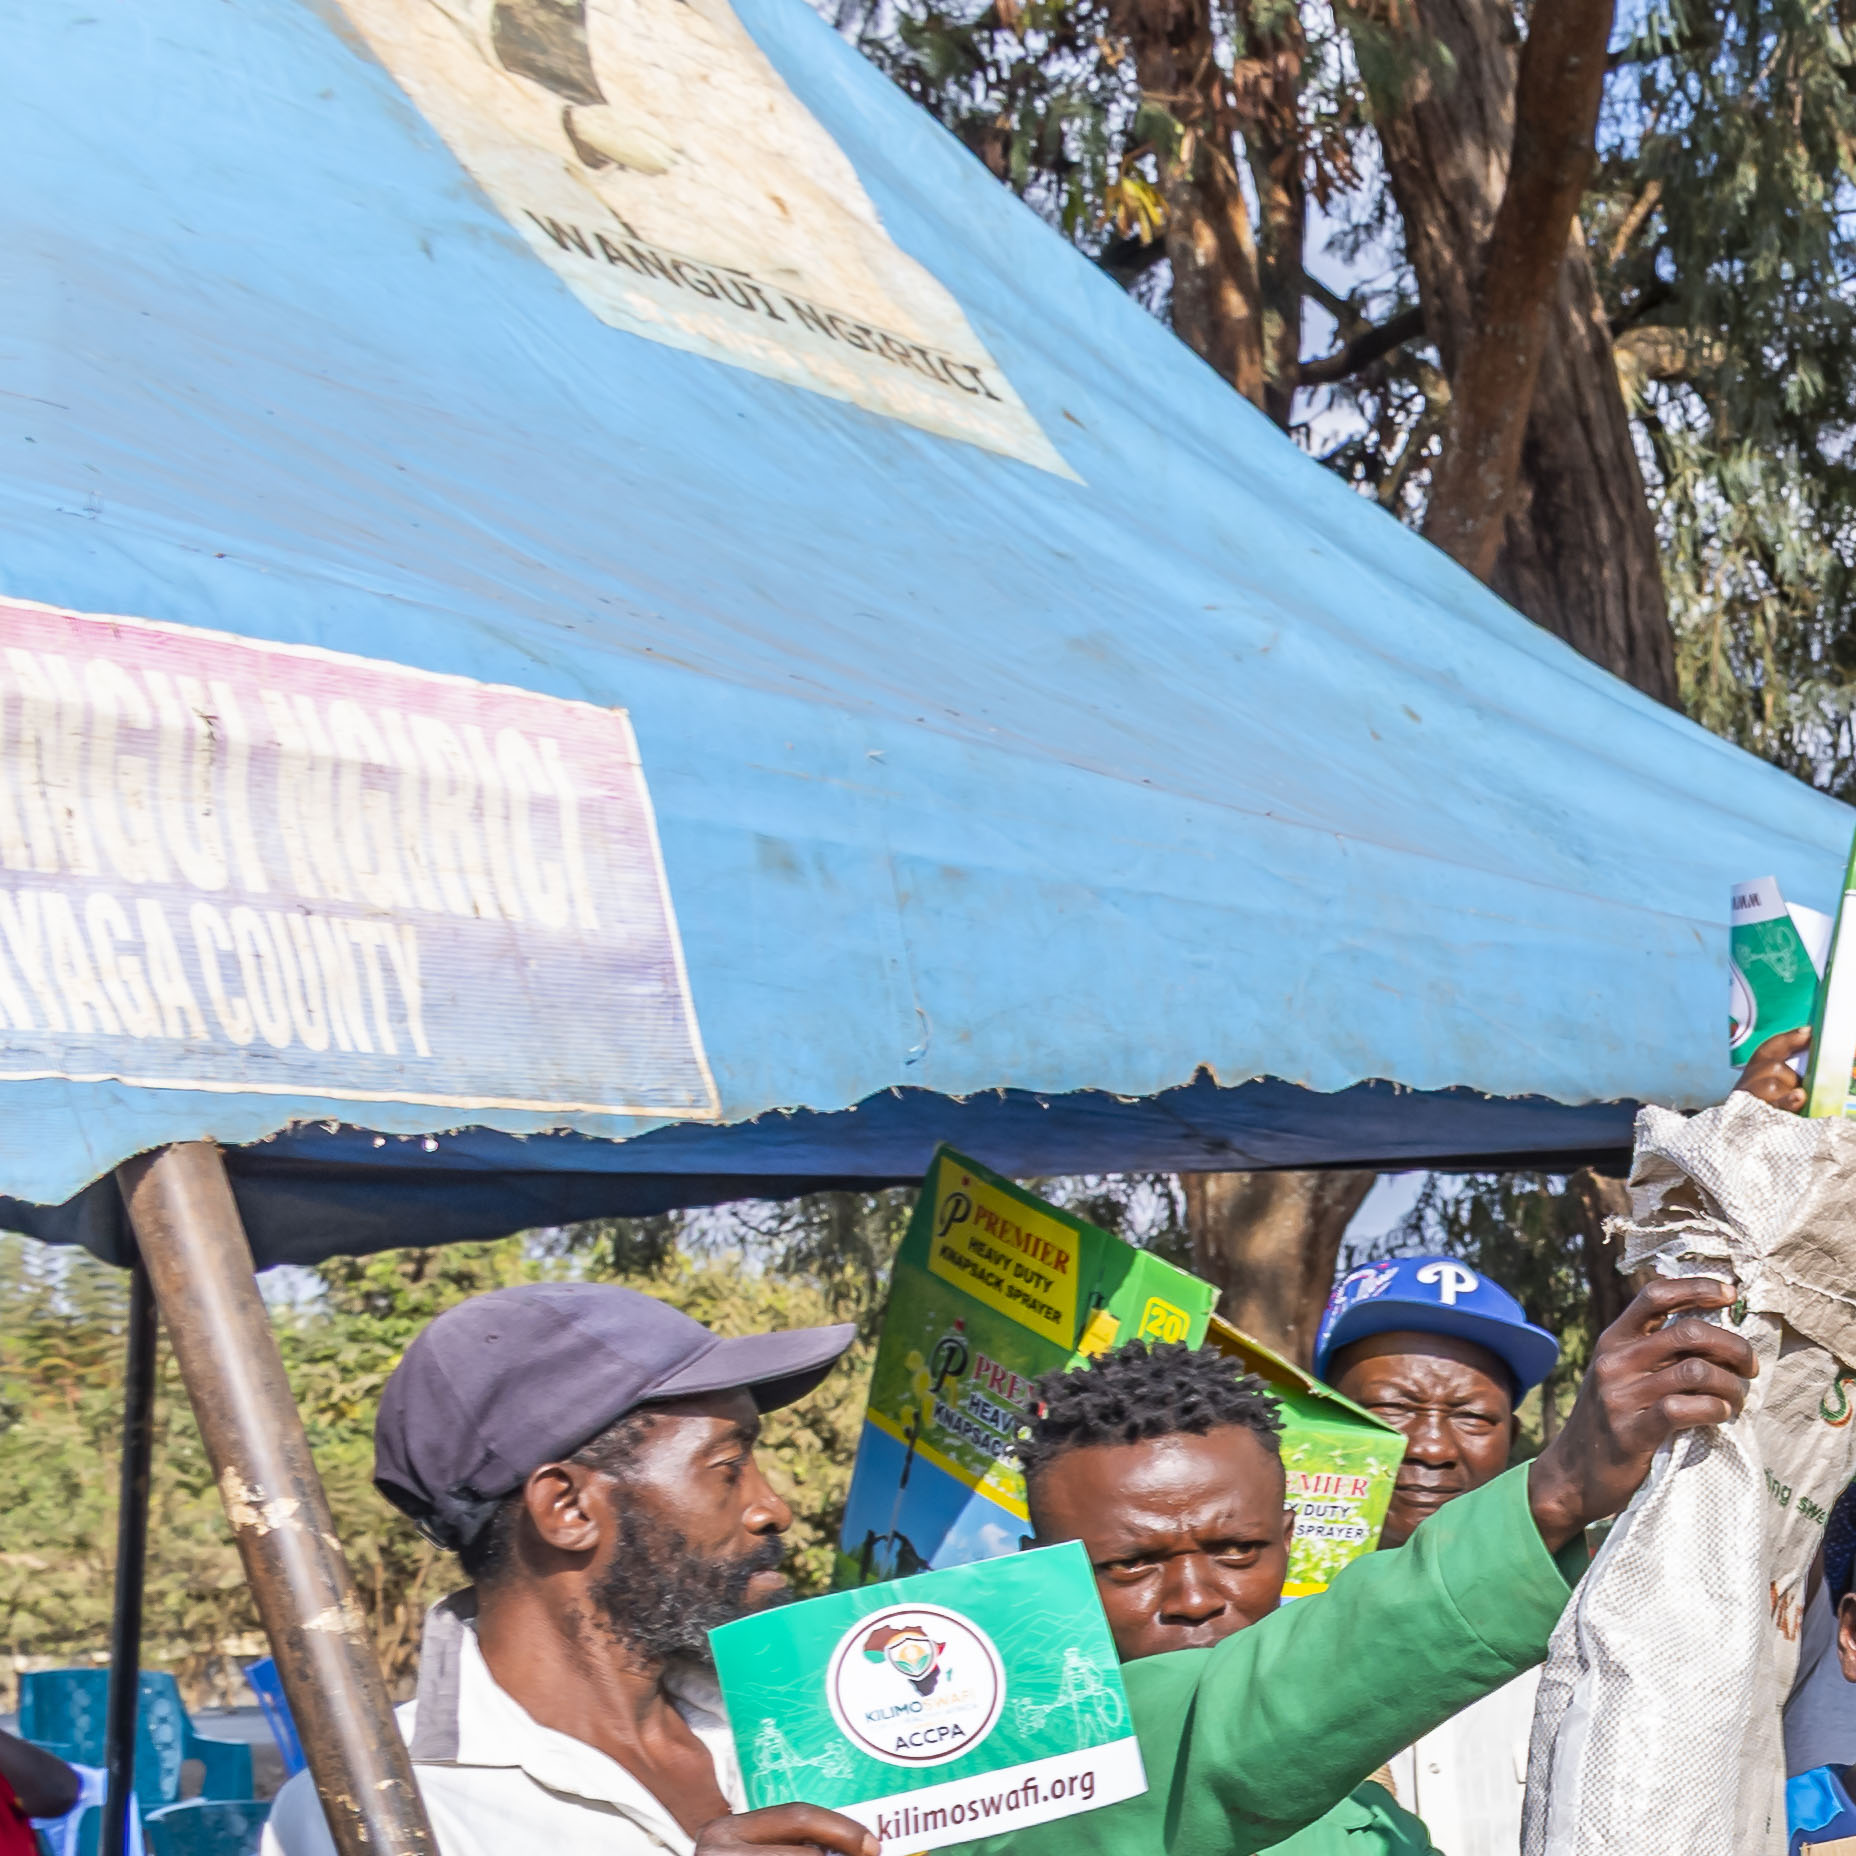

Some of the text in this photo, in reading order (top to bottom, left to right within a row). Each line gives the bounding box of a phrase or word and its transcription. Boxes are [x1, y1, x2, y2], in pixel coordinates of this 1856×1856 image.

[521, 207, 787, 322] WANGUI
[0, 646, 598, 930] NGUI NGIRICI
[0, 887, 431, 1057] YAGA COUNTY
[968, 1236, 1055, 1294] HEAVY DUTY
[972, 1204, 1071, 1275] PREMIER
[939, 1243, 1064, 1326] KNAPSACK SPRAYER
[1416, 1260, 1480, 1306] P
[1146, 1305, 1182, 1345] 20
[934, 1400, 1007, 1459] KNAPSAC
[968, 1391, 1015, 1434] HEAV
[1295, 1524, 1365, 1539] SPRAYER
[1303, 1503, 1351, 1518] DUTY
[894, 1722, 966, 1752] ACCPA
